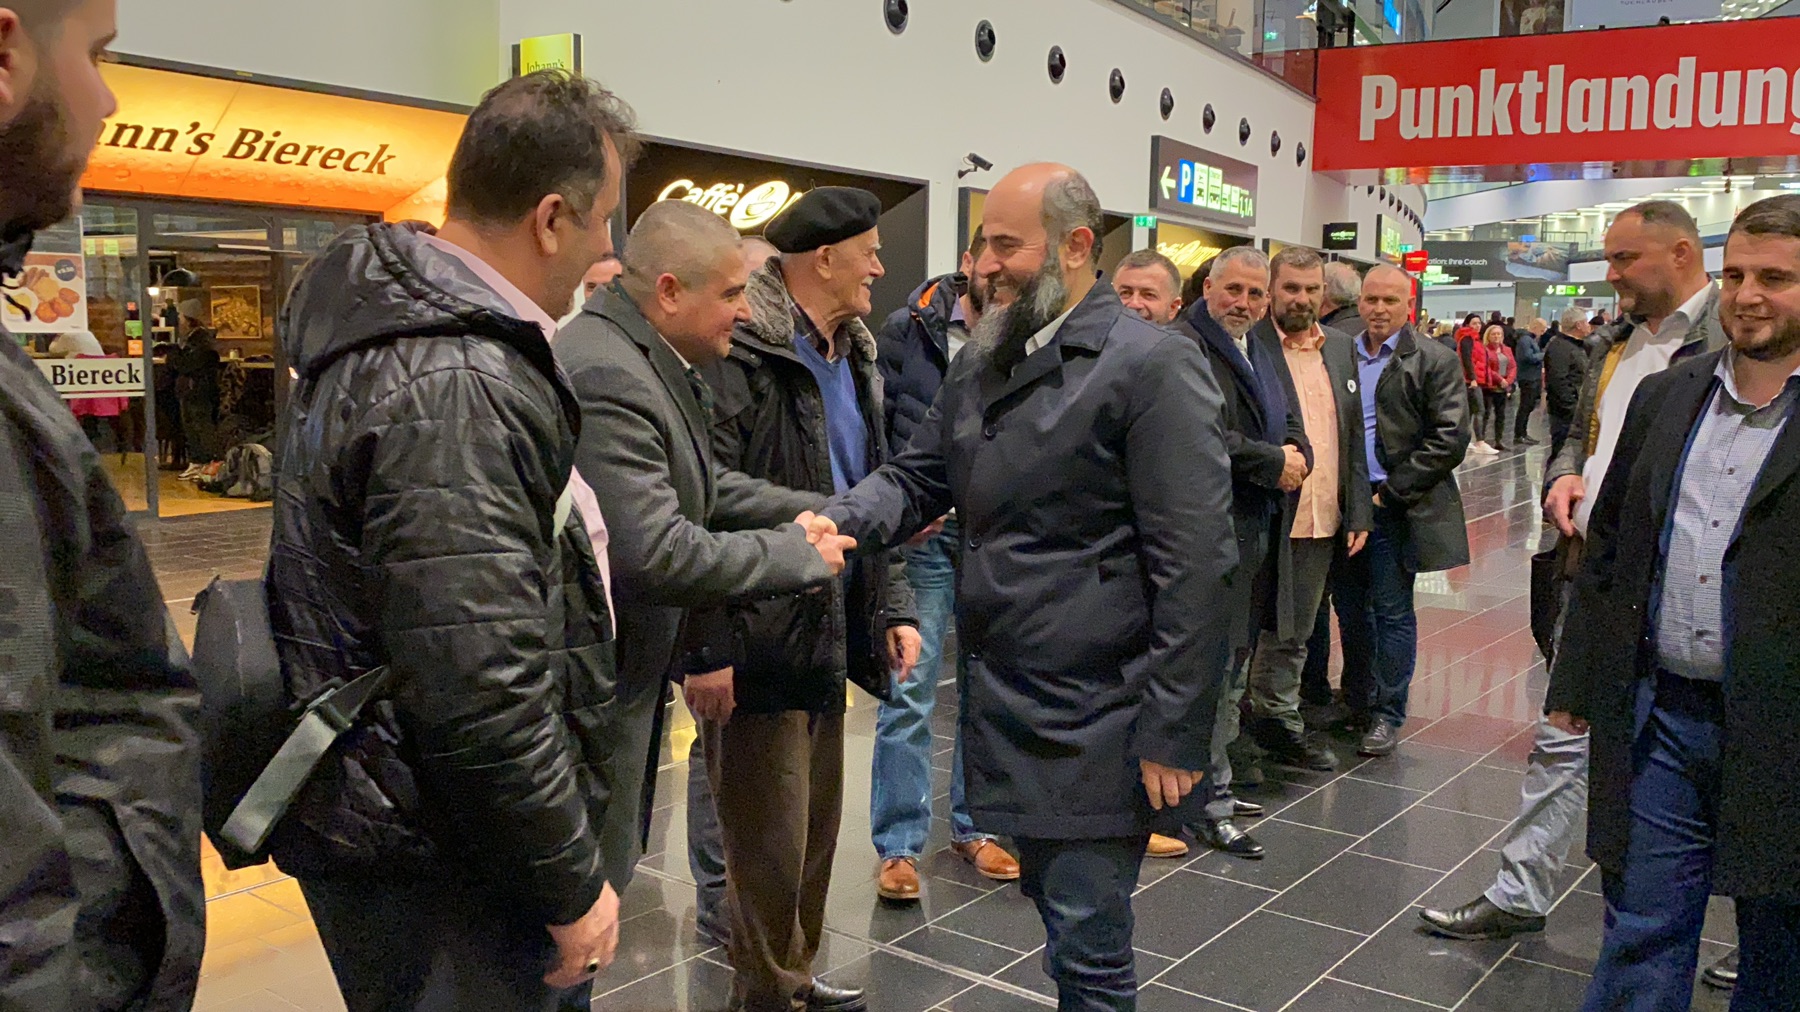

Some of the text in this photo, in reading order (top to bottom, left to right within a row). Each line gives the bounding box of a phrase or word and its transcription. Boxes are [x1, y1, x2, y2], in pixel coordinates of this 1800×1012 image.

[1359, 56, 1800, 141] Punktlandun
[96, 120, 396, 175] nn's Biereck
[1181, 163, 1191, 198] P
[1448, 258, 1463, 266] Ihre
[1463, 258, 1488, 266] Couch
[51, 363, 141, 385] Biereck
